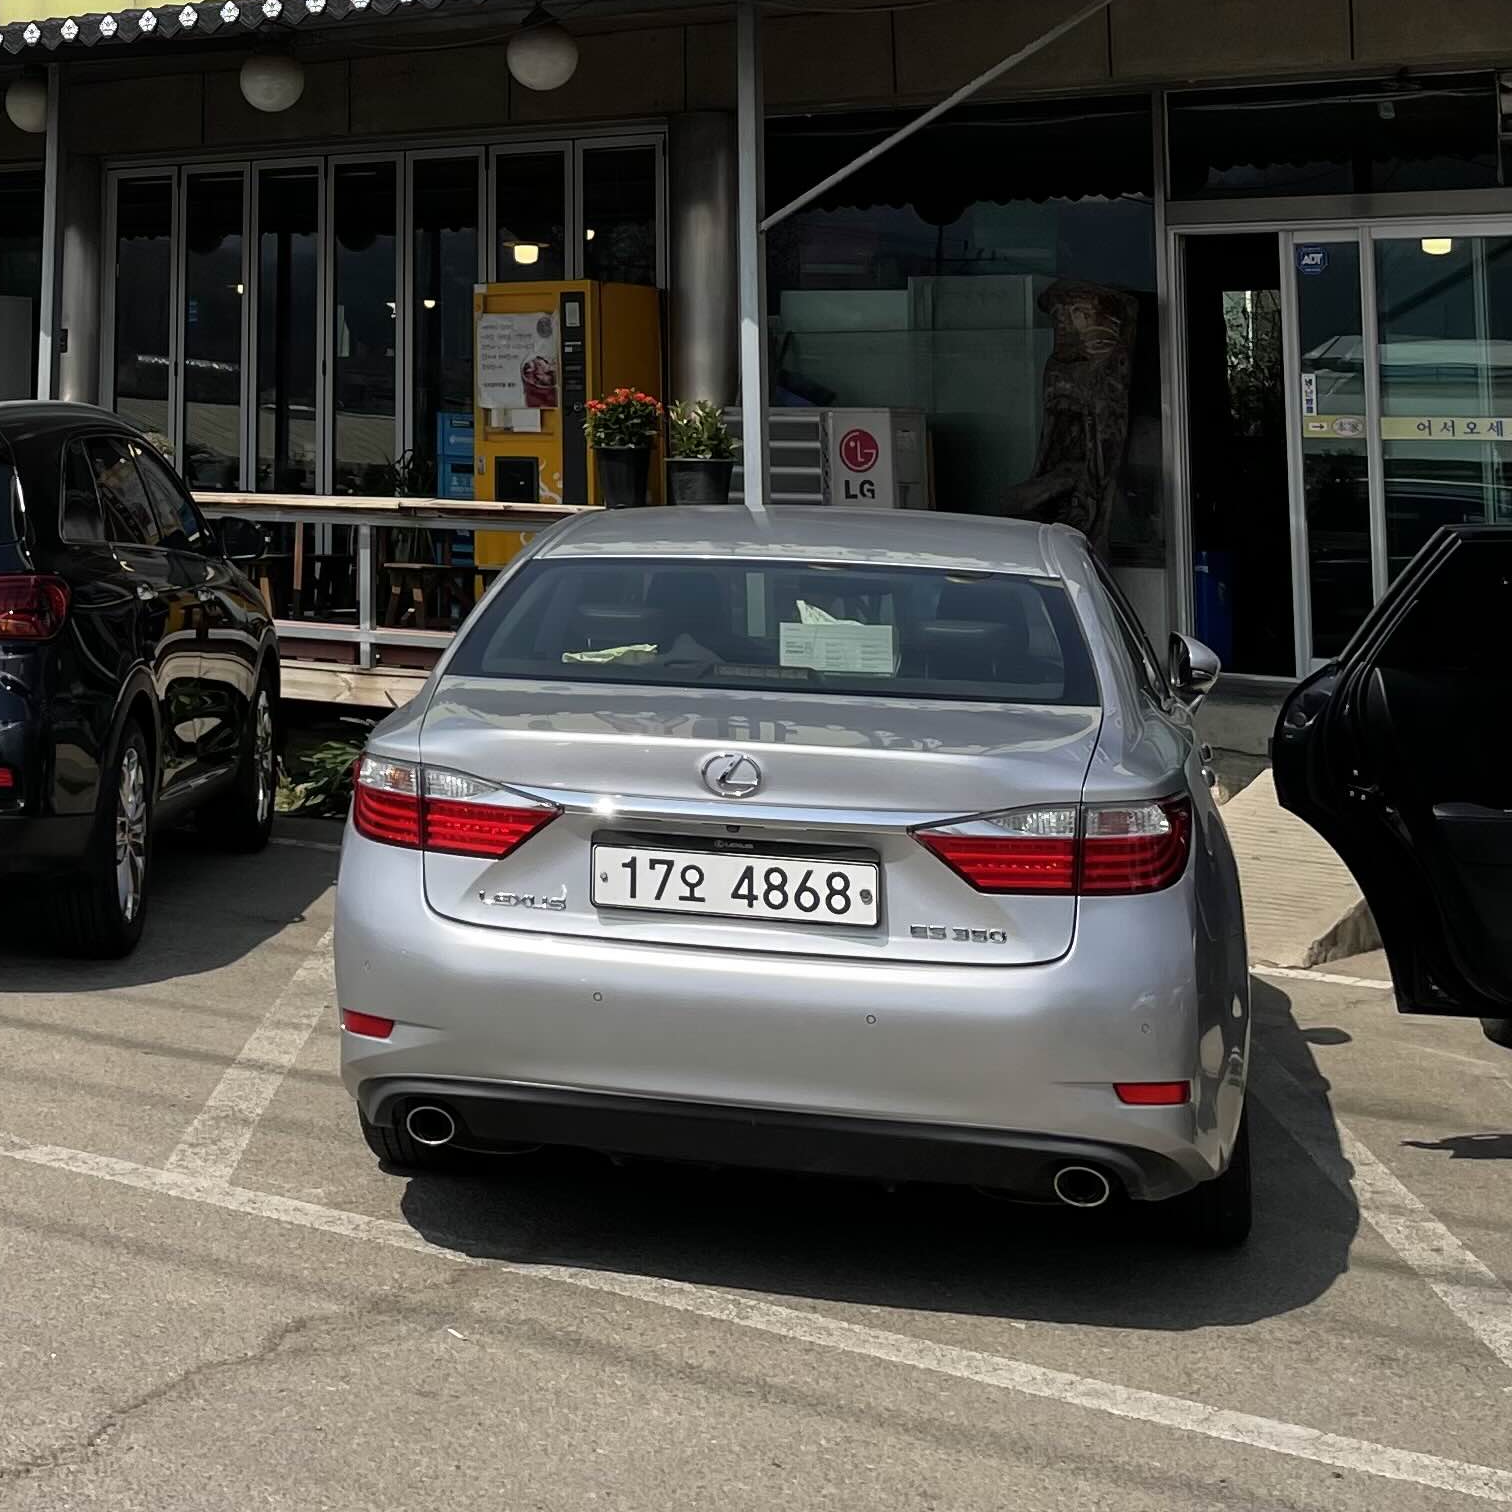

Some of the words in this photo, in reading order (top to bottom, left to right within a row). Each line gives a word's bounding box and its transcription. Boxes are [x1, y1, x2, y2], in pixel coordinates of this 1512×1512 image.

[1300, 253, 1323, 265] ADT
[844, 479, 875, 500] LG
[621, 855, 706, 903] 17오
[730, 864, 852, 915] 4868
[479, 890, 567, 911] LEXUS
[909, 925, 947, 940] ES
[952, 928, 1008, 945] 350
